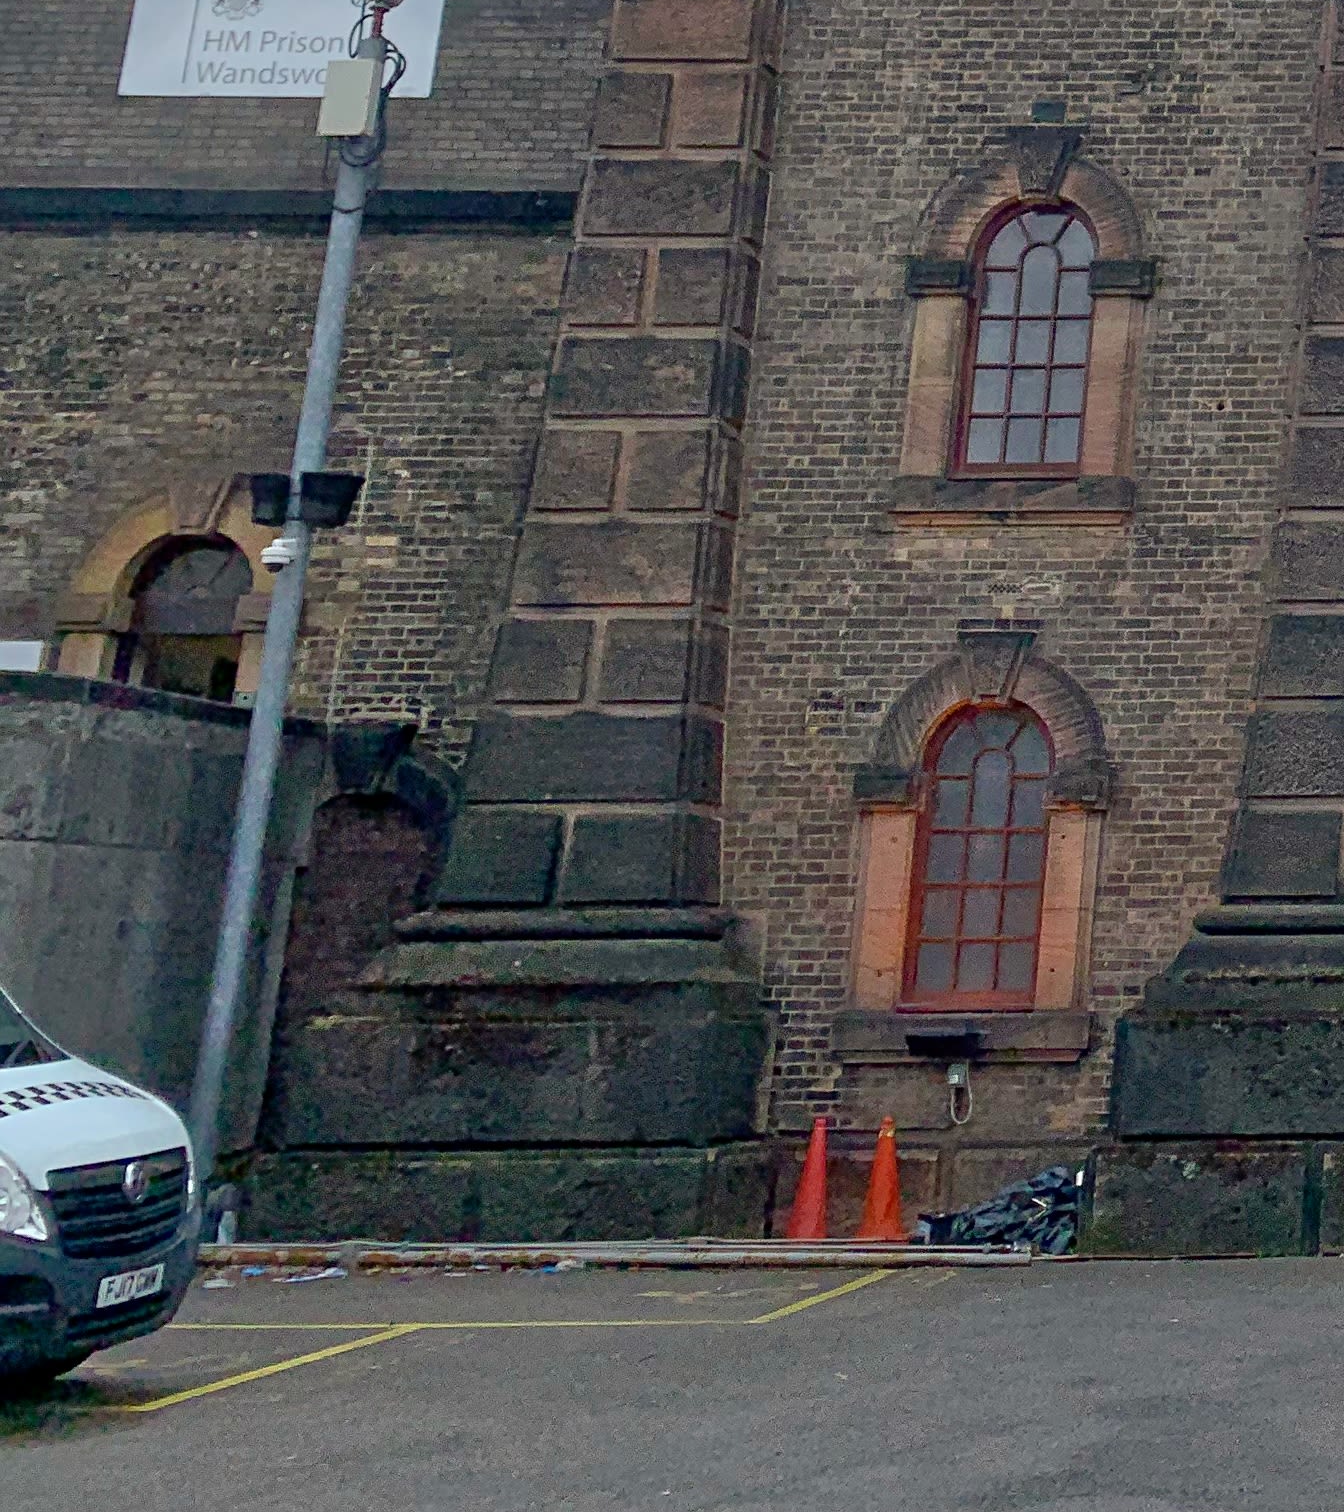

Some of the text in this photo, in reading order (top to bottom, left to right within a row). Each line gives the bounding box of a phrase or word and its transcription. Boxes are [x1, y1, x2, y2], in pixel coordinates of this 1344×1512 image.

[202, 30, 344, 53] HM Prison
[197, 61, 328, 85] Wandswo
